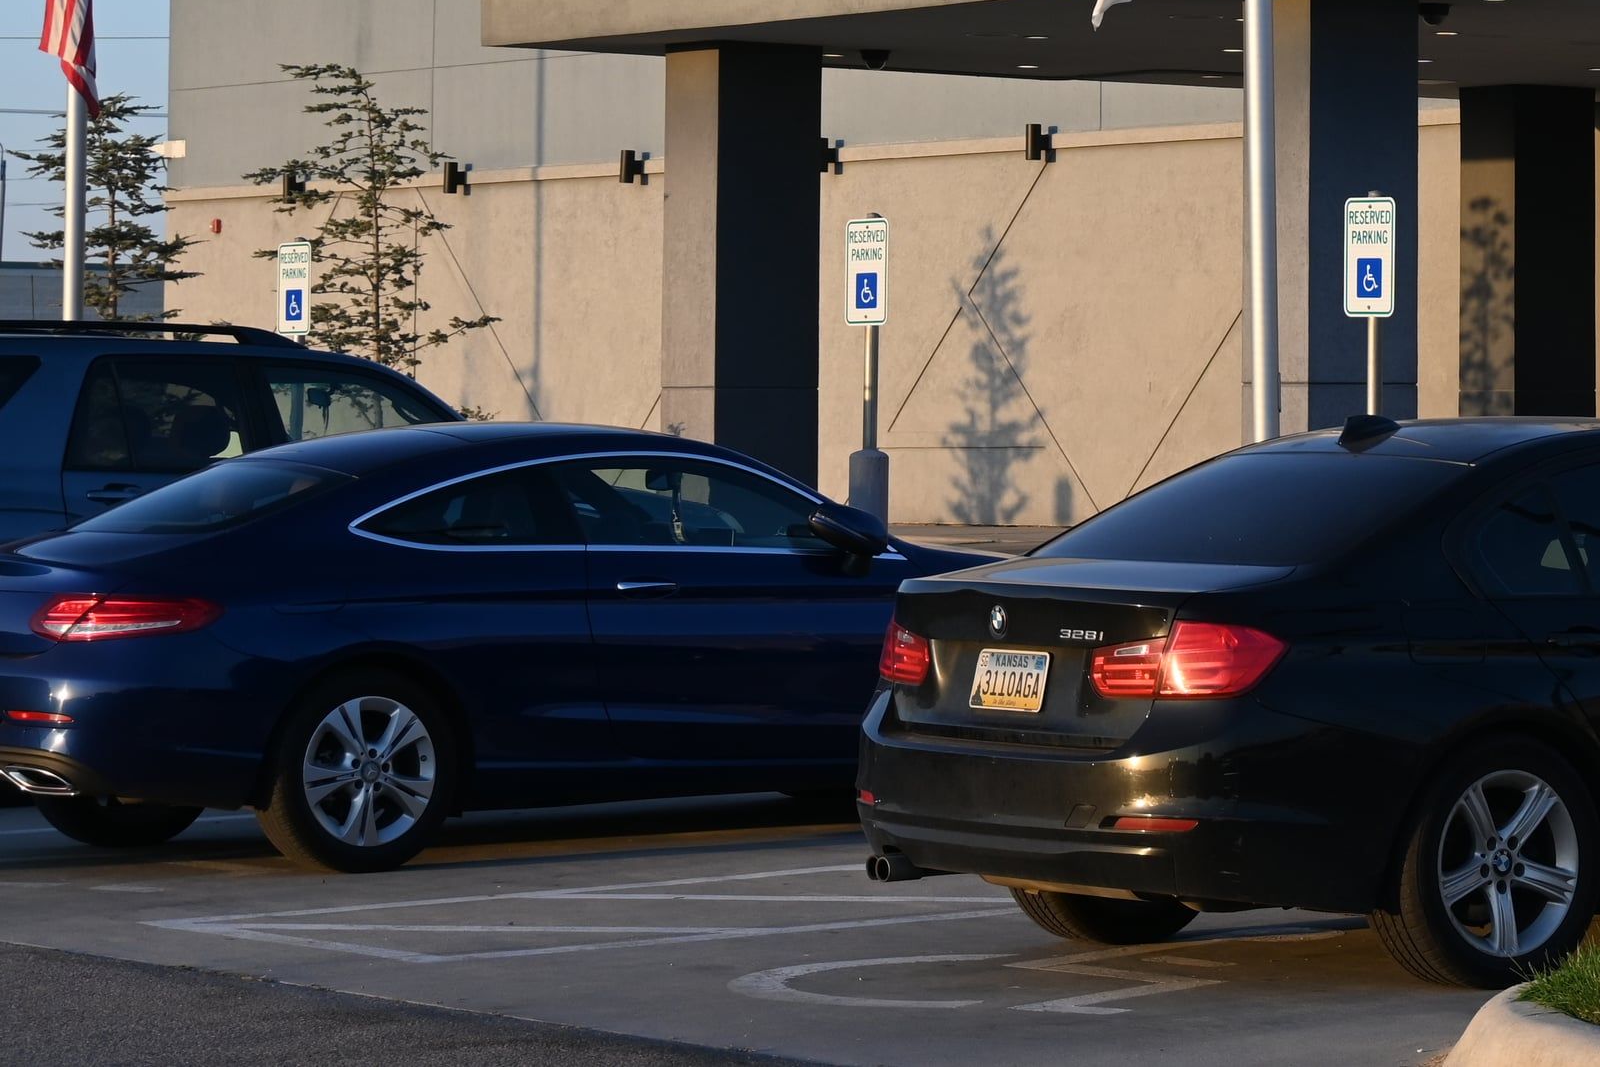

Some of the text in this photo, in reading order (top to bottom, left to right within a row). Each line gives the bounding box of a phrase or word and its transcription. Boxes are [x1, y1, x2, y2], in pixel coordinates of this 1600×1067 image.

[1349, 210, 1390, 224] RESERVED
[849, 229, 885, 244] RESERVED
[1352, 230, 1388, 244] PARKING
[280, 252, 308, 264] RESERVED
[851, 247, 883, 261] PARKING
[282, 268, 307, 279] PARKING
[995, 655, 1029, 668] KANSAS
[982, 669, 1040, 699] 3110AGA
